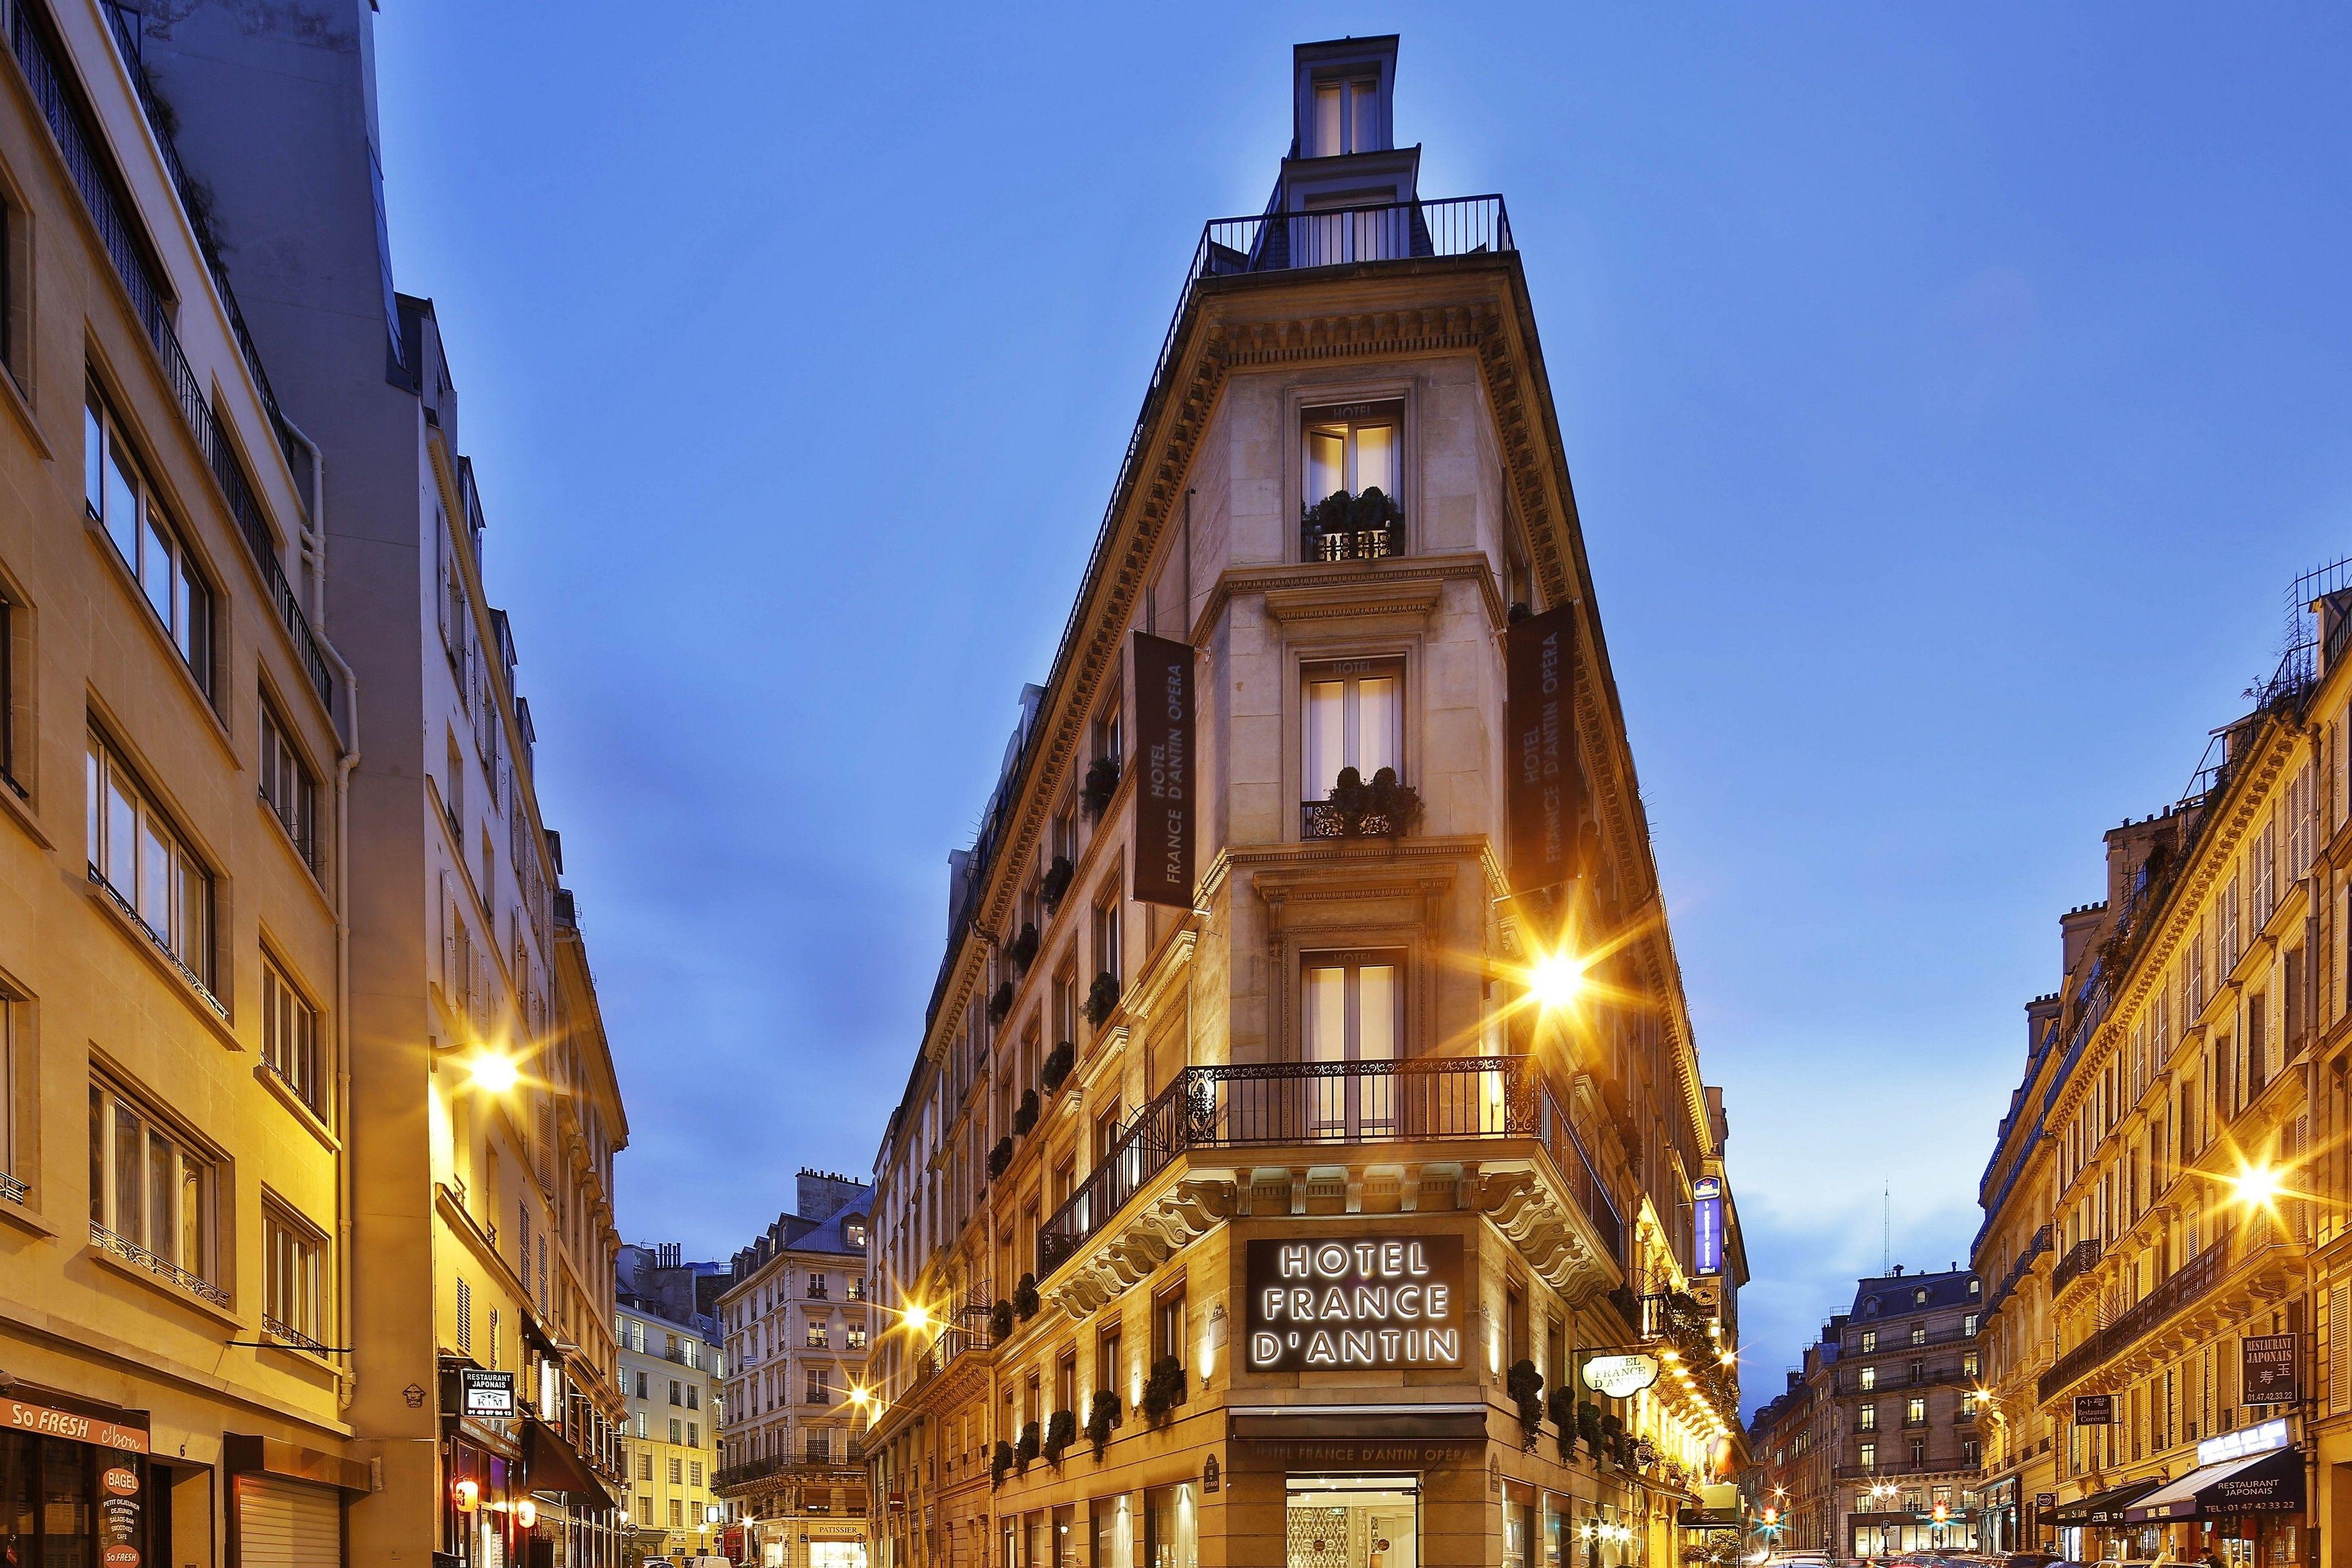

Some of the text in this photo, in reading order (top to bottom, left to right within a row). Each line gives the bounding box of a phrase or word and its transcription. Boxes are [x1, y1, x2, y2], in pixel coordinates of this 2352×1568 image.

[1333, 405, 1371, 419] HOTEL
[1333, 662, 1372, 674] HOTEL
[1544, 700, 1558, 776] D'ANTIN
[1525, 726, 1539, 785] HOTEL
[1151, 744, 1165, 798] HOTEL
[1168, 729, 1182, 801] D'ANTIN
[1544, 784, 1561, 863] FRANCE
[1167, 808, 1182, 884] FRANCE
[1334, 952, 1372, 963] HOTEL
[1283, 1243, 1428, 1277] HOTEL
[1265, 1286, 1447, 1321] FRANCE
[1254, 1329, 1457, 1363] D'ANTIN
[2247, 1338, 2291, 1351] RESTAURANT
[2247, 1350, 2292, 1363] JAPONAIS
[467, 1373, 511, 1382] RESTAURANT
[1595, 1366, 1646, 1378] FRANCE
[2247, 1392, 2293, 1401] 01.47.42.33.22
[37, 1410, 89, 1438] FRESH
[179, 1444, 186, 1457] 6
[1298, 1449, 1354, 1461] FRANCE
[1362, 1449, 1417, 1462] D'ANTIN
[1425, 1447, 1471, 1462] OPÉRA
[108, 1472, 137, 1490] BAGEL
[2218, 1479, 2280, 1490] RESTAURANT
[2225, 1487, 2273, 1497] JAPONAIS
[103, 1498, 140, 1511] PETIT DEJEUNER
[110, 1507, 133, 1516] DEJEUNER
[109, 1515, 134, 1525] SALADE-BAR
[111, 1525, 133, 1533] SMOOTHIES
[107, 1552, 137, 1562] So FRESH
